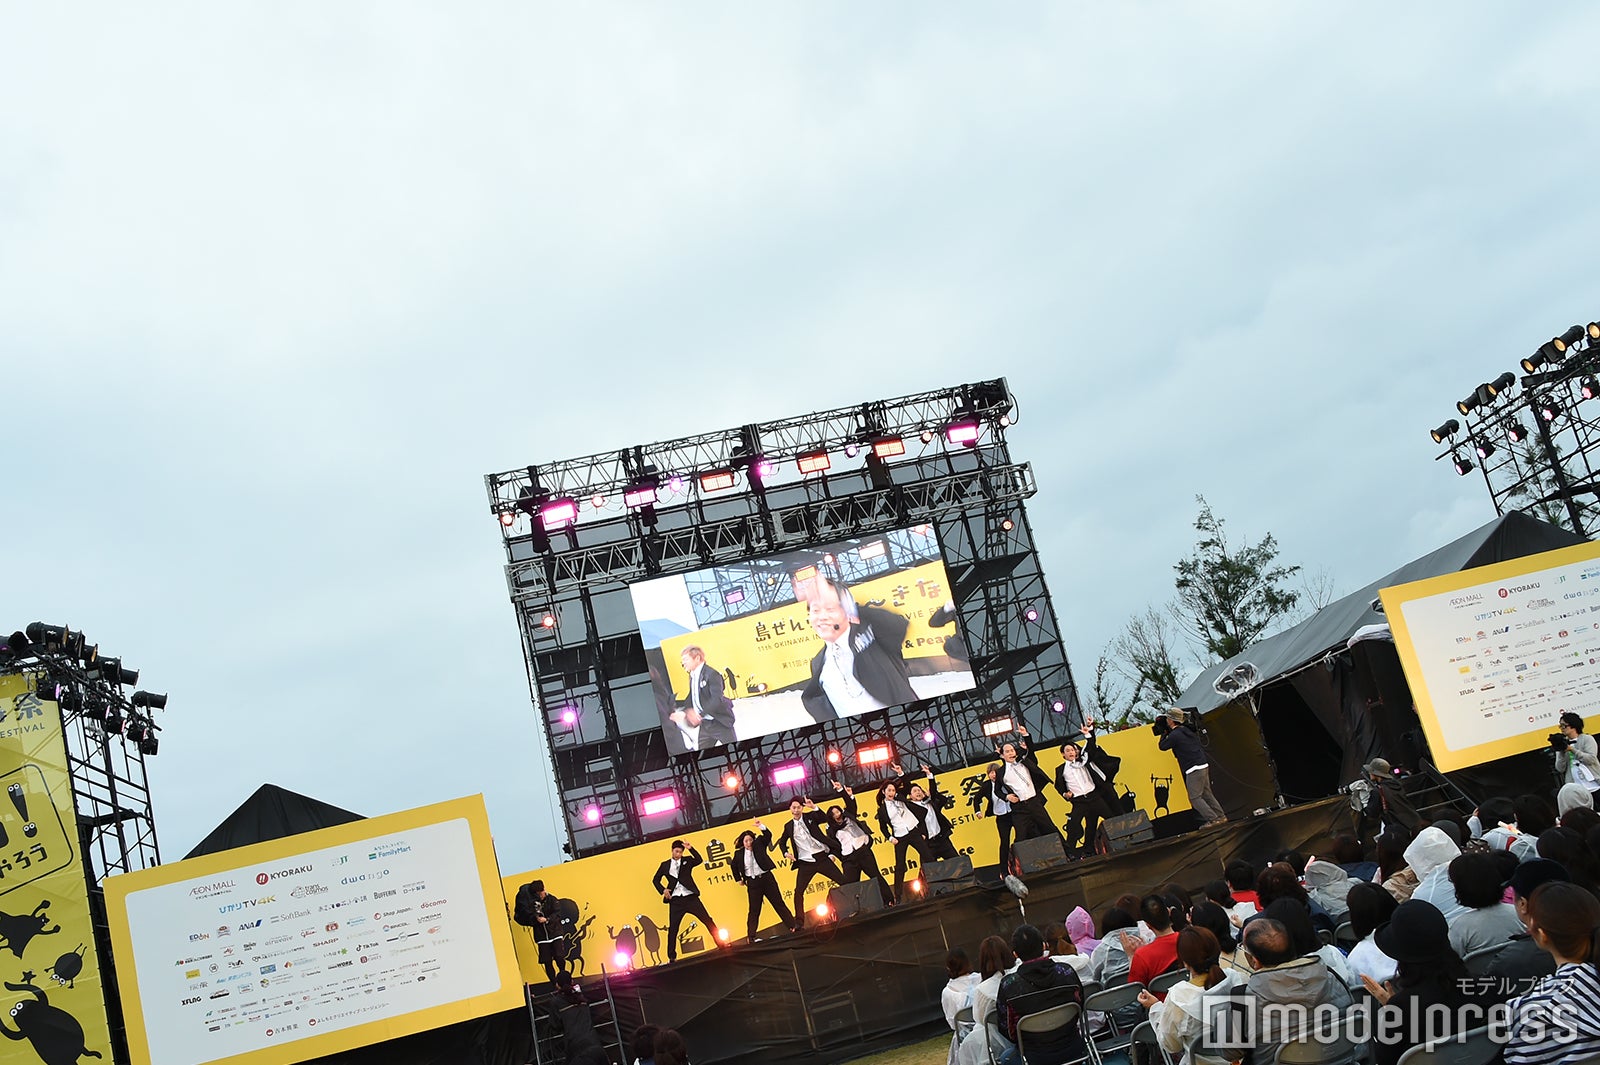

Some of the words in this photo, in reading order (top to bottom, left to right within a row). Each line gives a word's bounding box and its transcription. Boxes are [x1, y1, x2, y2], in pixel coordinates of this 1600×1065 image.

[1508, 582, 1541, 595] KYORAKU
[774, 635, 810, 649] OKINAWA
[905, 640, 914, 649] &
[378, 845, 412, 859] FamilyMart
[340, 855, 349, 866] JT
[270, 864, 313, 880] KYORAKU
[340, 868, 390, 885] dwango
[707, 872, 733, 885] 11th
[212, 880, 236, 891] MALL
[420, 898, 447, 909] docomo
[280, 908, 312, 922] SoftBank
[238, 921, 256, 932] ANA
[312, 938, 339, 948] SHARP
